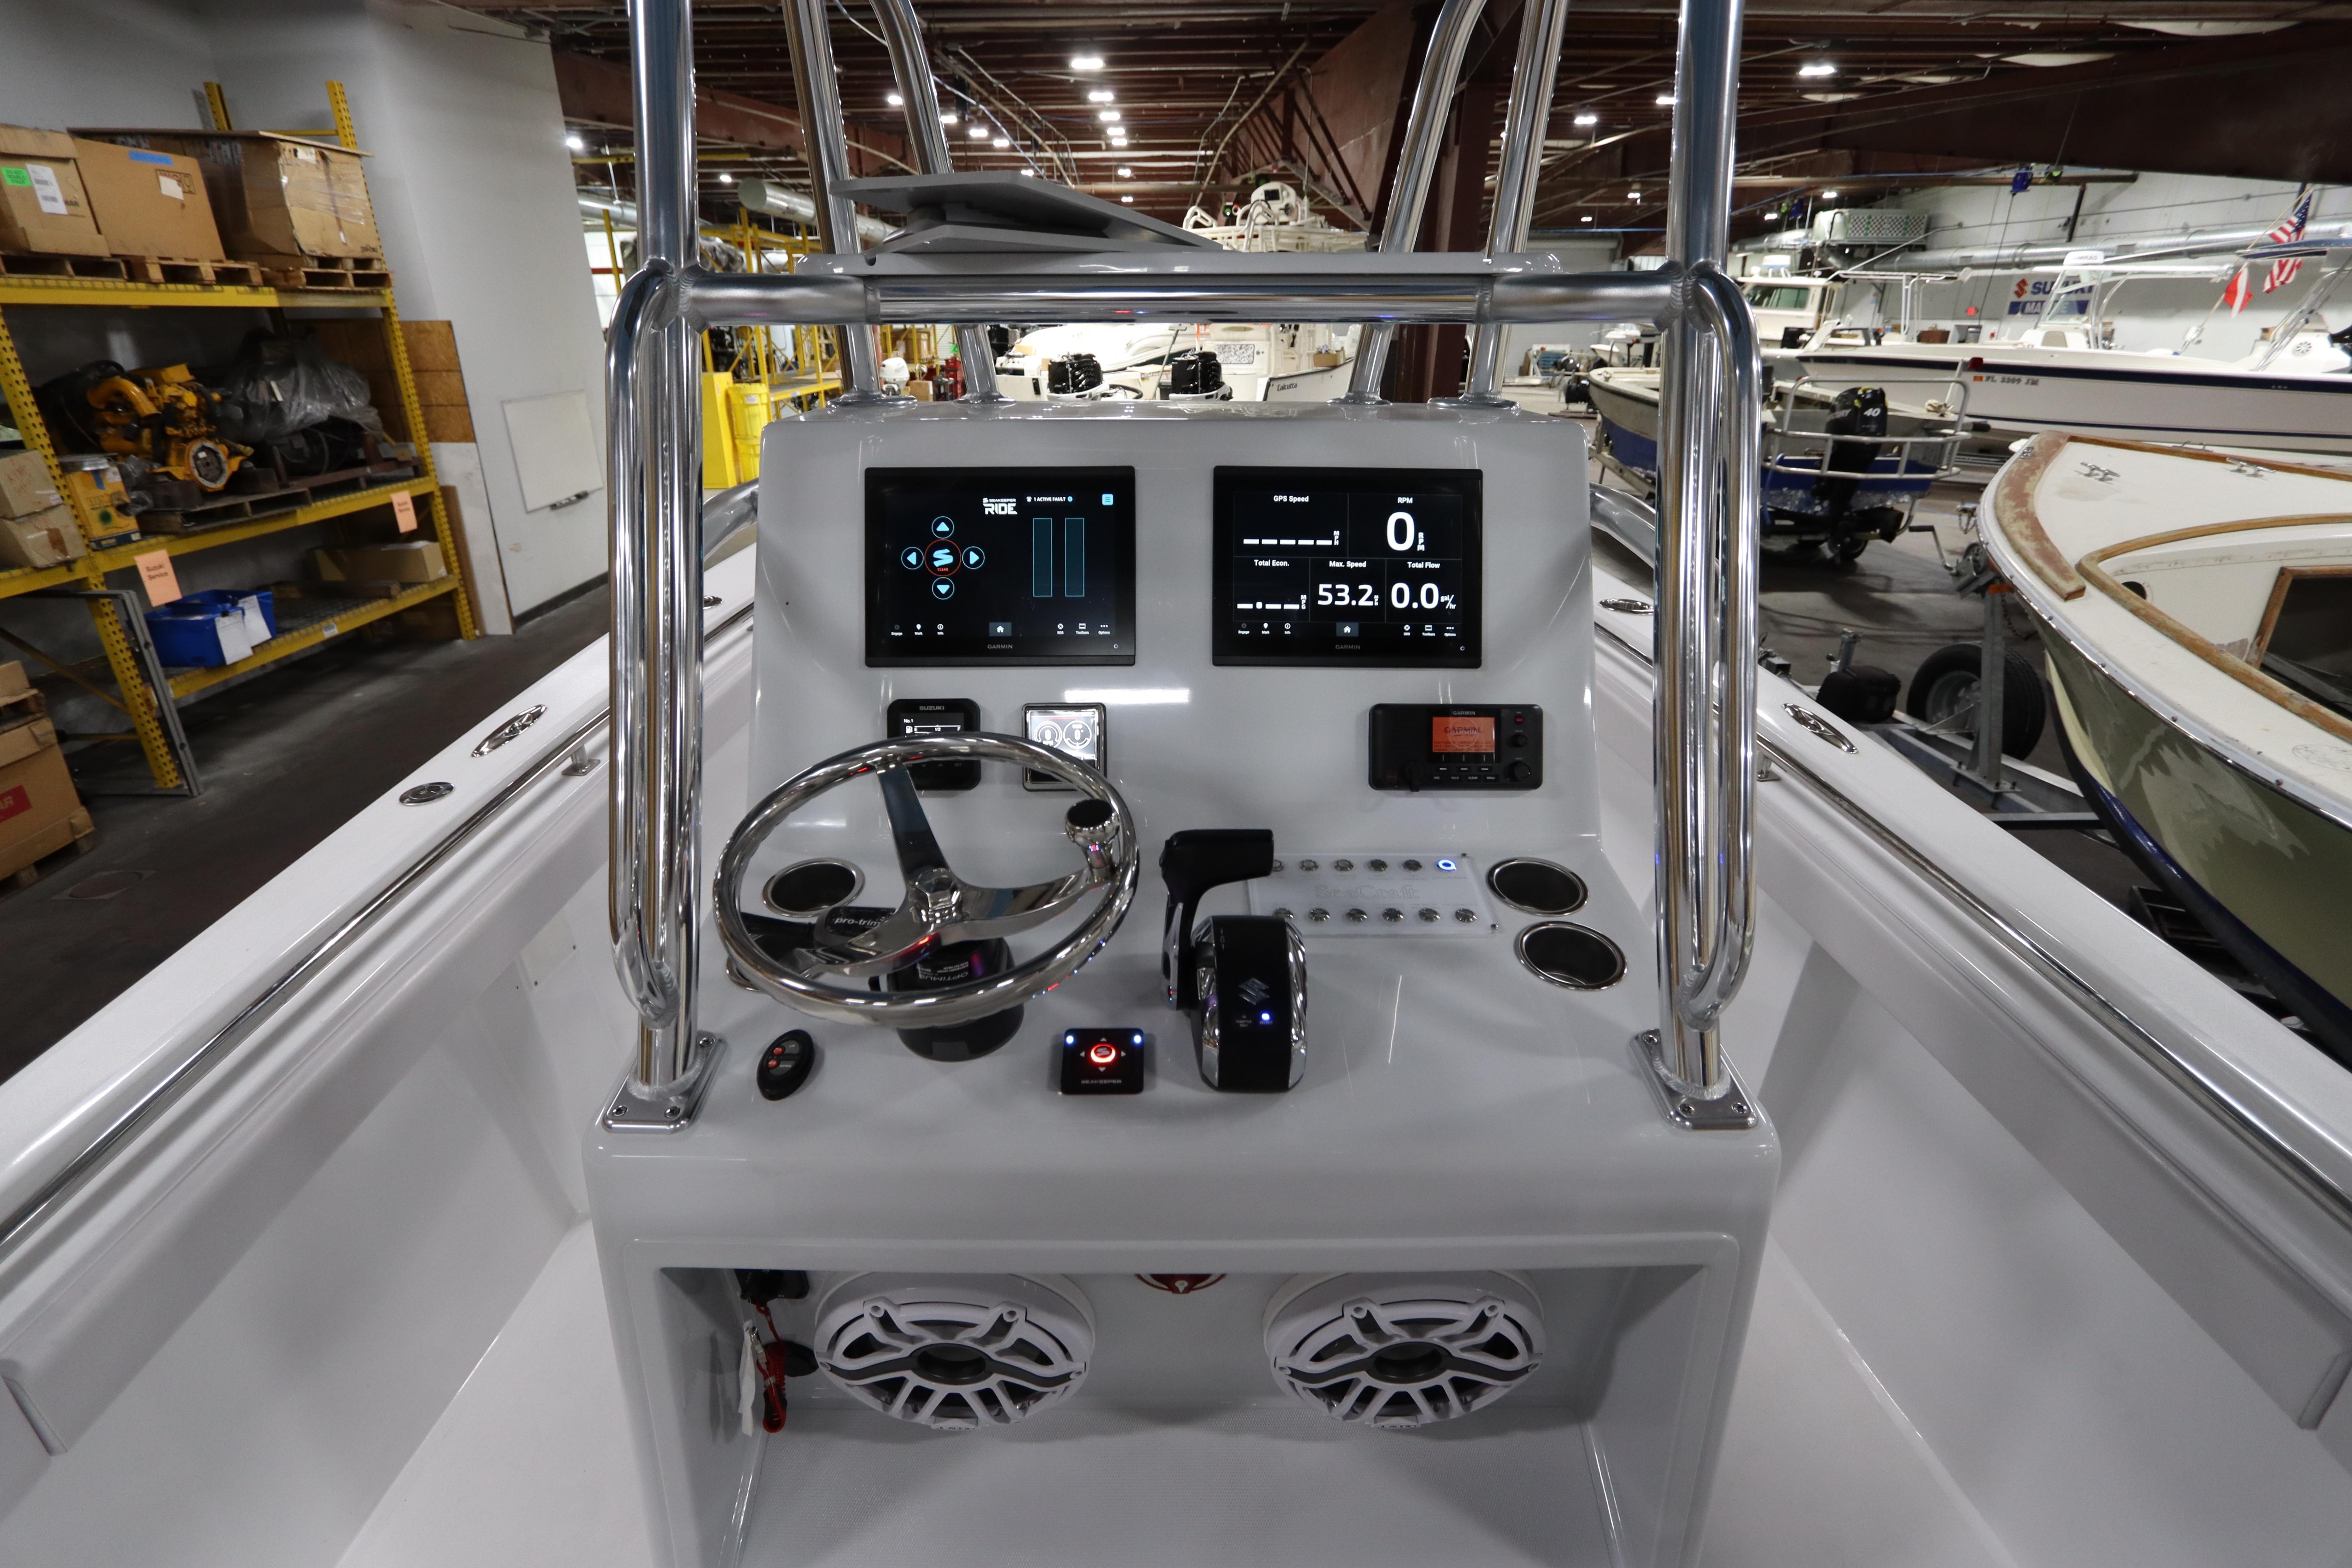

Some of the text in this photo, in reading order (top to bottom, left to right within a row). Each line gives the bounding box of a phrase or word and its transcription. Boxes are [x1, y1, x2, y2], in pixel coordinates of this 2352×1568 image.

[1277, 382, 1297, 391] Calcutta
[1863, 407, 1881, 417] 40
[1289, 495, 1309, 503] Speed
[983, 503, 1018, 515] RIDE
[1386, 511, 1425, 551] 0 RPM
[146, 563, 165, 571] Suzuki
[1346, 561, 1367, 569] Speed
[148, 572, 168, 581] Service
[1317, 584, 1374, 606] 53.2
[1391, 582, 1439, 609] 0.0
[1315, 884, 1420, 900] SeaCraft
[834, 917, 880, 926] pro-trim
[920, 971, 968, 981] OPTIMUS
